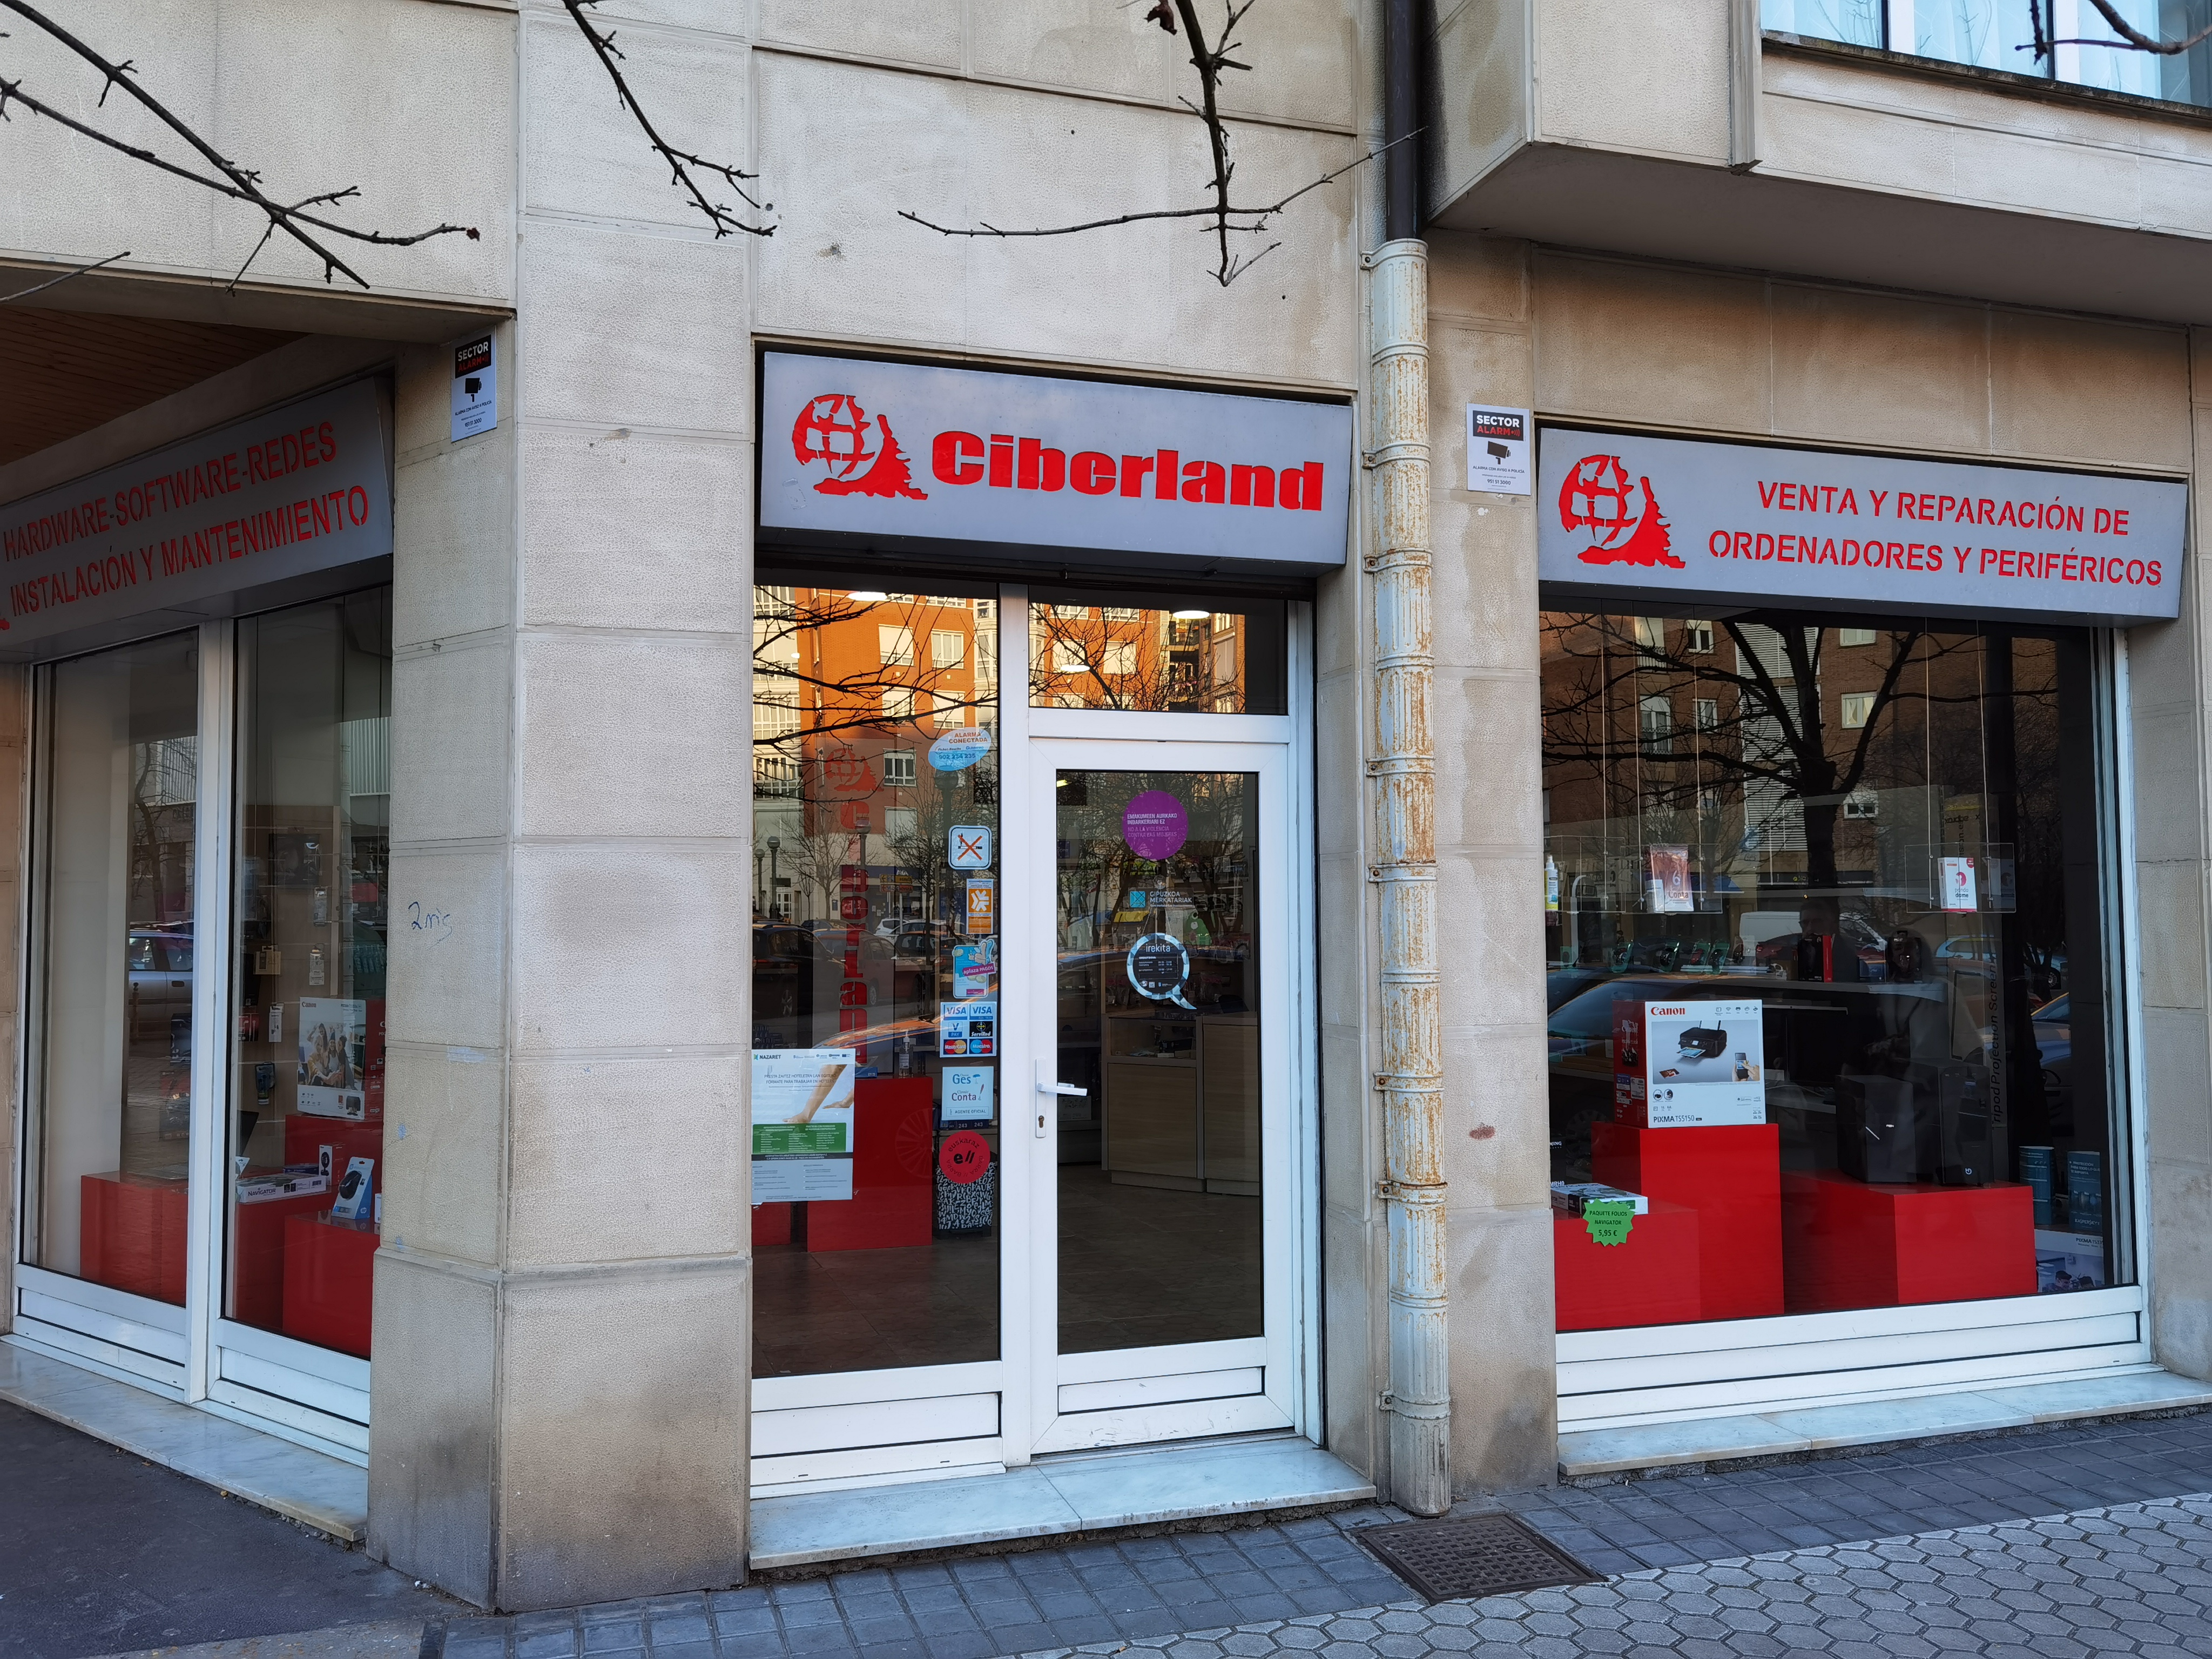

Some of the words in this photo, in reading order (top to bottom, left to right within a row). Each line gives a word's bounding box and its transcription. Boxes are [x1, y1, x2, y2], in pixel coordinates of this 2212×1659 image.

[458, 341, 489, 361] SECTOR
[458, 356, 482, 372] ALARM
[1476, 414, 1520, 428] SECTOR
[1477, 425, 1511, 436] ALARM
[932, 430, 1324, 511] Ciberland
[1758, 481, 1859, 516] VENTA
[1870, 490, 1889, 517] Y
[1897, 492, 2084, 533] REPARACIÓN
[2094, 508, 2130, 536] DE
[11, 545, 137, 616] INSTALACIÓN
[139, 545, 153, 581] Y
[161, 485, 368, 577] MANTENIMIENTO
[1709, 530, 1943, 572] ORDENADORES
[1953, 546, 1972, 574] Y
[1980, 547, 2162, 587] PERIFÉRICOS
[1145, 943, 1171, 952] irekita
[1988, 964, 1998, 1011] Screen
[947, 1007, 967, 1015] VISA
[972, 1006, 992, 1014] VISA
[1650, 1006, 1686, 1016] Canon
[952, 1074, 972, 1084] Ges
[952, 1092, 976, 1101] Conta
[1653, 1115, 1675, 1123] PIXMA
[948, 1137, 980, 1152] euskaraz
